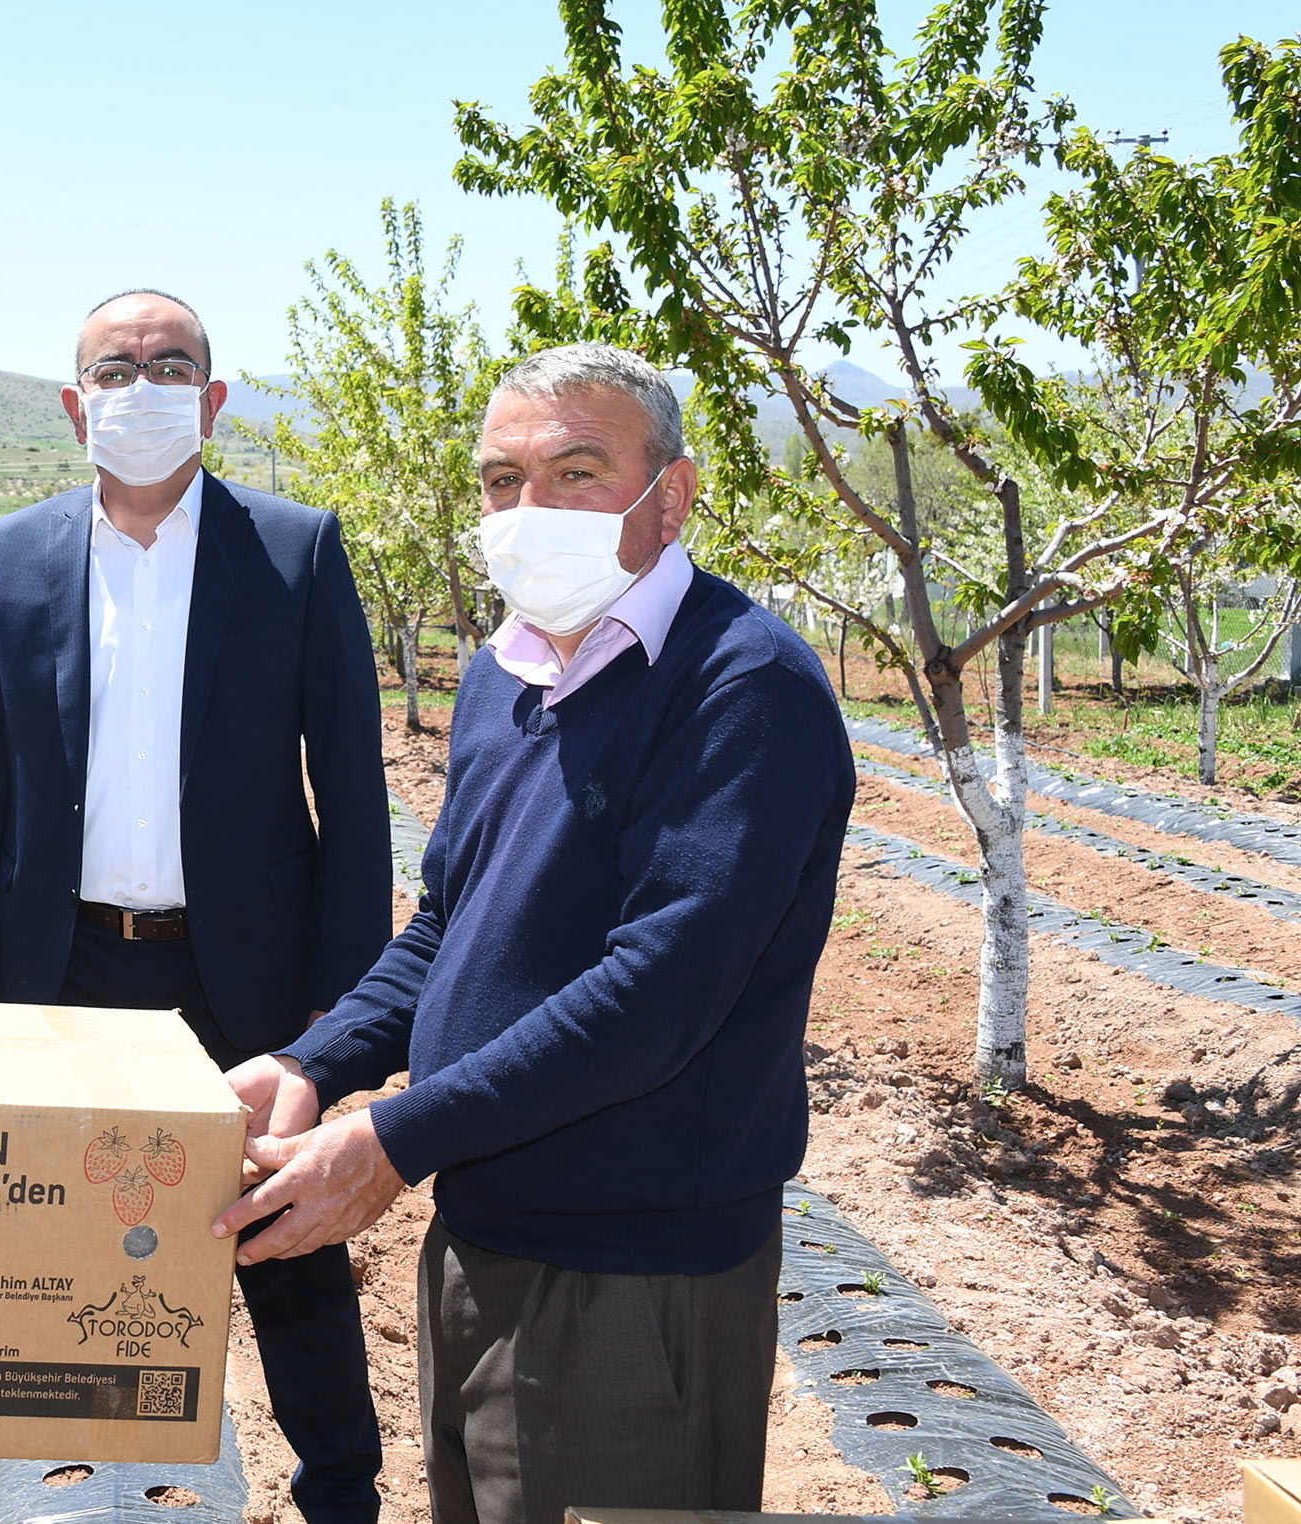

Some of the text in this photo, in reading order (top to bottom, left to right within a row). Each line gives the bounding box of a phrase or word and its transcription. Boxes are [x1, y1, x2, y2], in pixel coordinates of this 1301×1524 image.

[31, 1277, 74, 1291] ALTAY
[5, 1291, 39, 1301] Belediye
[41, 1293, 73, 1303] Başkanı
[88, 1319, 184, 1338] TORODOS
[5, 1371, 62, 1385] Büyükşehir
[64, 1373, 117, 1386] Belediyesi
